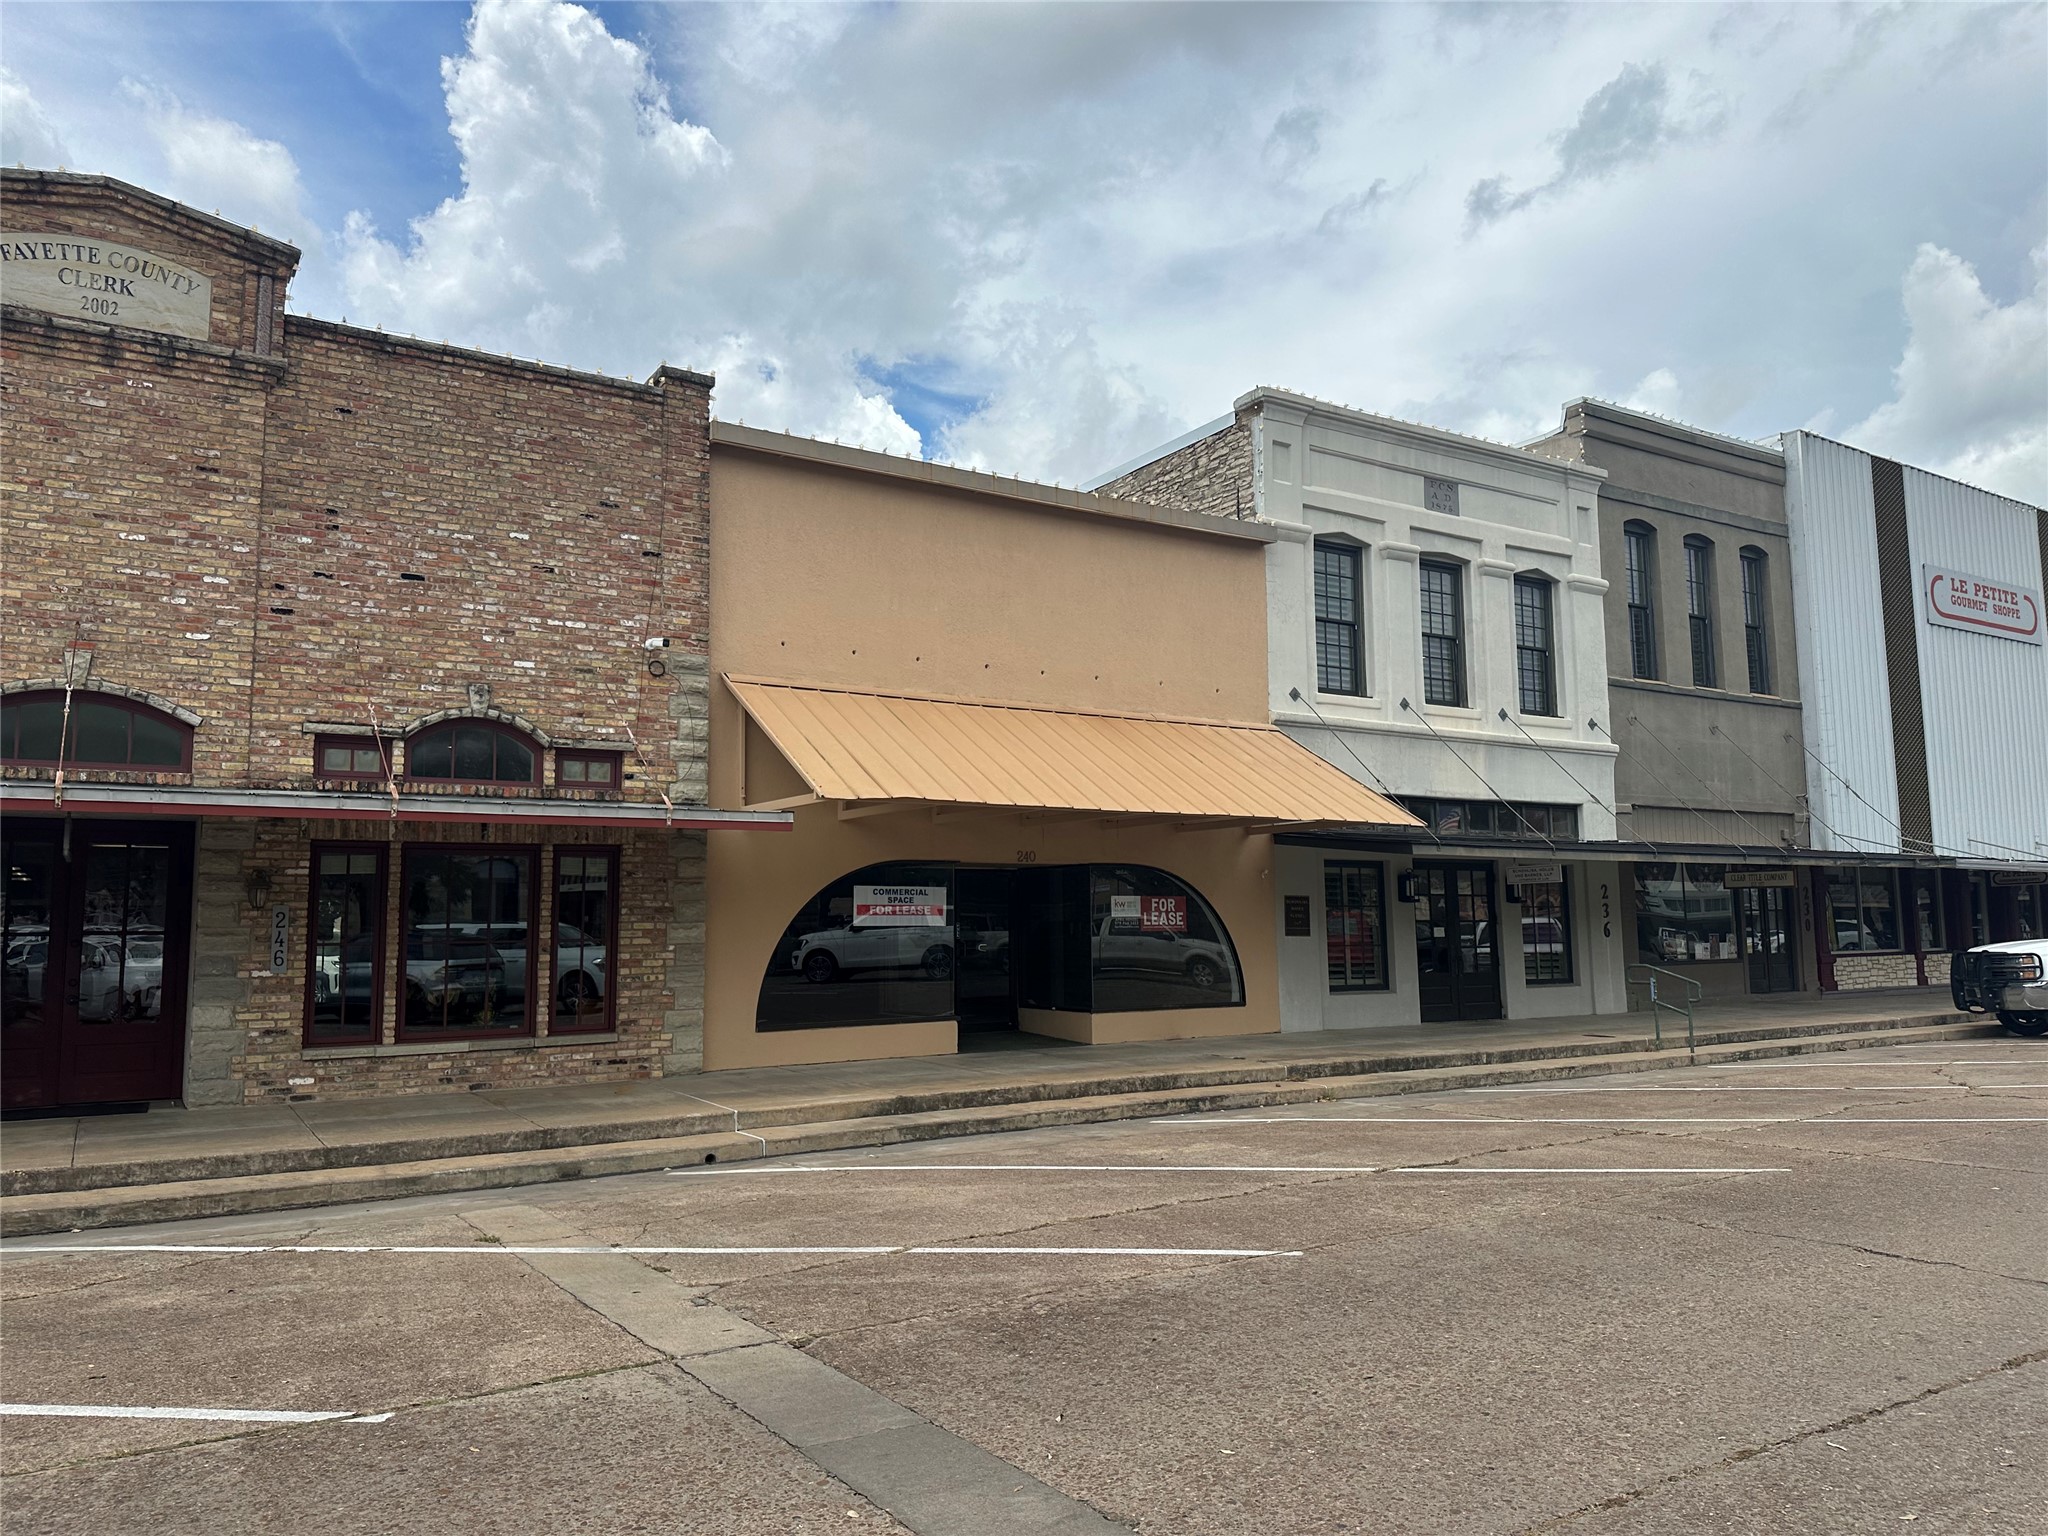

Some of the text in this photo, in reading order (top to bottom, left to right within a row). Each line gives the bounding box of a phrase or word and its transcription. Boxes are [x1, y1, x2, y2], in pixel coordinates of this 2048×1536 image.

[0, 242, 201, 297] FAYETTE COUNTY
[57, 267, 135, 298] CLERK
[80, 296, 119, 316] 2002
[1950, 577, 2019, 606] LE PETITE
[1950, 594, 2021, 619] GOURMET SHOPPE
[1016, 850, 1036, 862] 240
[1747, 873, 1763, 881] TITLE
[1763, 872, 1788, 881] COMPANY
[872, 888, 929, 896] COMMERCIAL
[887, 896, 915, 904] SPACE
[1114, 898, 1126, 909] kw
[1151, 898, 1176, 912] FOR
[869, 905, 931, 915] FOR LEASE
[1600, 884, 1611, 938] 236
[1143, 911, 1184, 926] LEASE
[273, 911, 286, 967] 246
